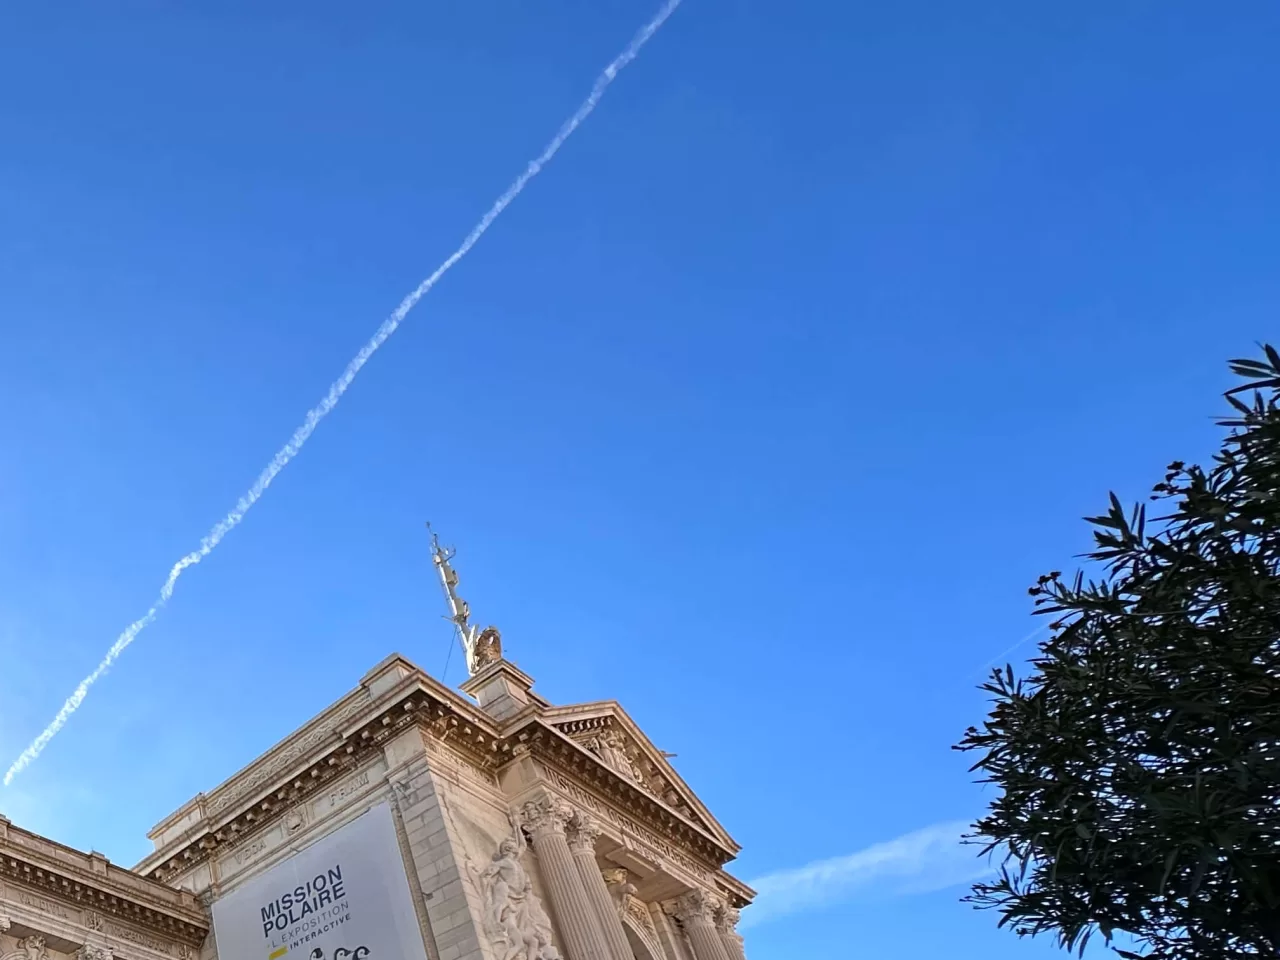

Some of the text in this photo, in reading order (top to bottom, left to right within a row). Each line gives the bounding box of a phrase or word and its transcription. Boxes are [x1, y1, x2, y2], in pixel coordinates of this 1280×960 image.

[329, 772, 370, 807] FRAM
[18, 892, 69, 919] VALDIVIA
[261, 864, 342, 922] MISSION
[263, 880, 346, 938] POLAIRE
[289, 912, 352, 950] INTERACTIVE
